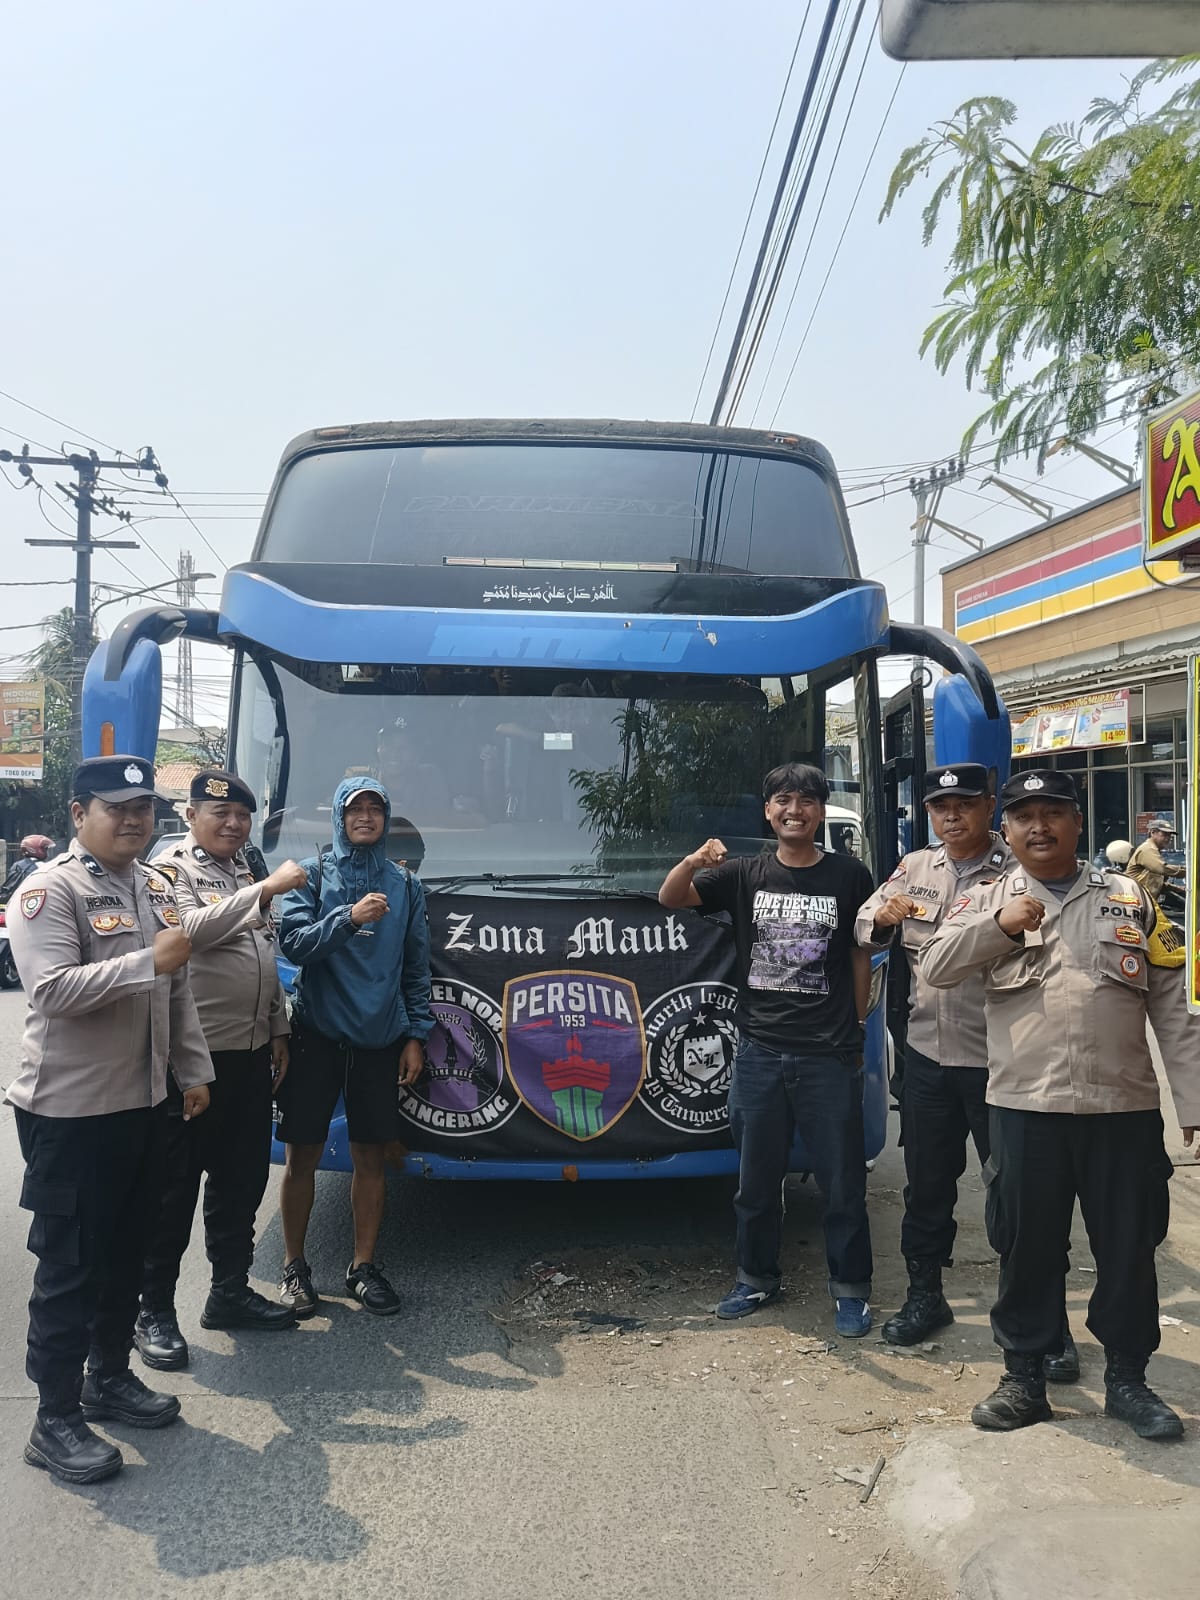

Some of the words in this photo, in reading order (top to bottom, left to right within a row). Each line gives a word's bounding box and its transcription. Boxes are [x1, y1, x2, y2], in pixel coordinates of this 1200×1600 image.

[197, 878, 227, 889] MUKTI
[908, 886, 939, 899] SURYADI
[752, 908, 779, 921] FILA
[781, 909, 804, 919] DEL
[806, 911, 837, 928] NORD
[753, 893, 781, 910] ONE
[782, 896, 837, 916] DECADE
[1100, 906, 1143, 920] POLR
[444, 912, 546, 954] Zona
[567, 914, 689, 960] Mauk
[428, 984, 456, 1002] EL
[461, 991, 503, 1044] NOR
[511, 982, 633, 1024] PERSITA
[646, 992, 693, 1038] north
[700, 987, 738, 1014] legi
[559, 1014, 586, 1027] 1953
[398, 1087, 509, 1128] TANGERANG
[660, 1093, 730, 1127] Tangera
